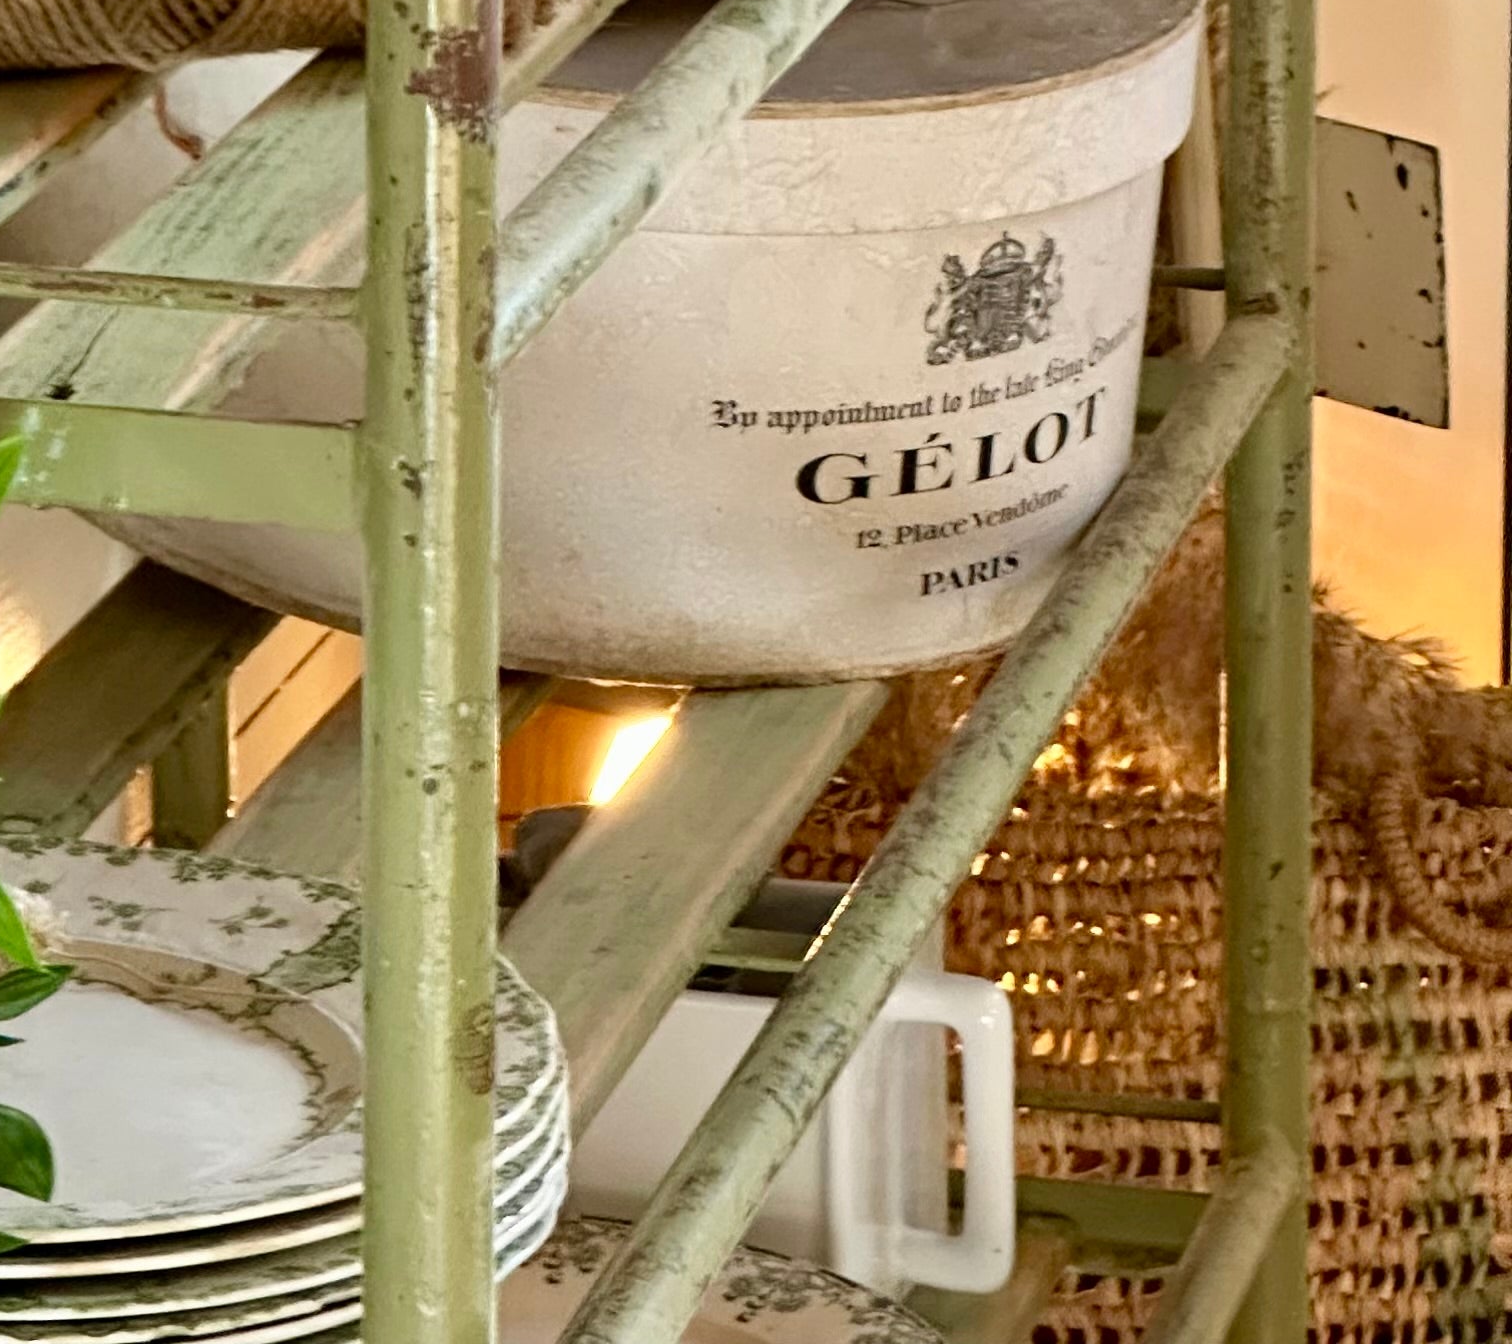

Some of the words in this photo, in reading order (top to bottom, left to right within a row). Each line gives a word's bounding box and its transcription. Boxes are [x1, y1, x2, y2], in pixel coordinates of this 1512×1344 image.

[766, 395, 933, 434] appointment
[942, 392, 962, 413] to
[968, 381, 1002, 409] the
[1004, 373, 1040, 399] late
[795, 386, 1109, 506] GÉLOT
[895, 517, 968, 545] Place
[972, 482, 1070, 529] Vendôme
[919, 550, 1020, 597] PARIS
